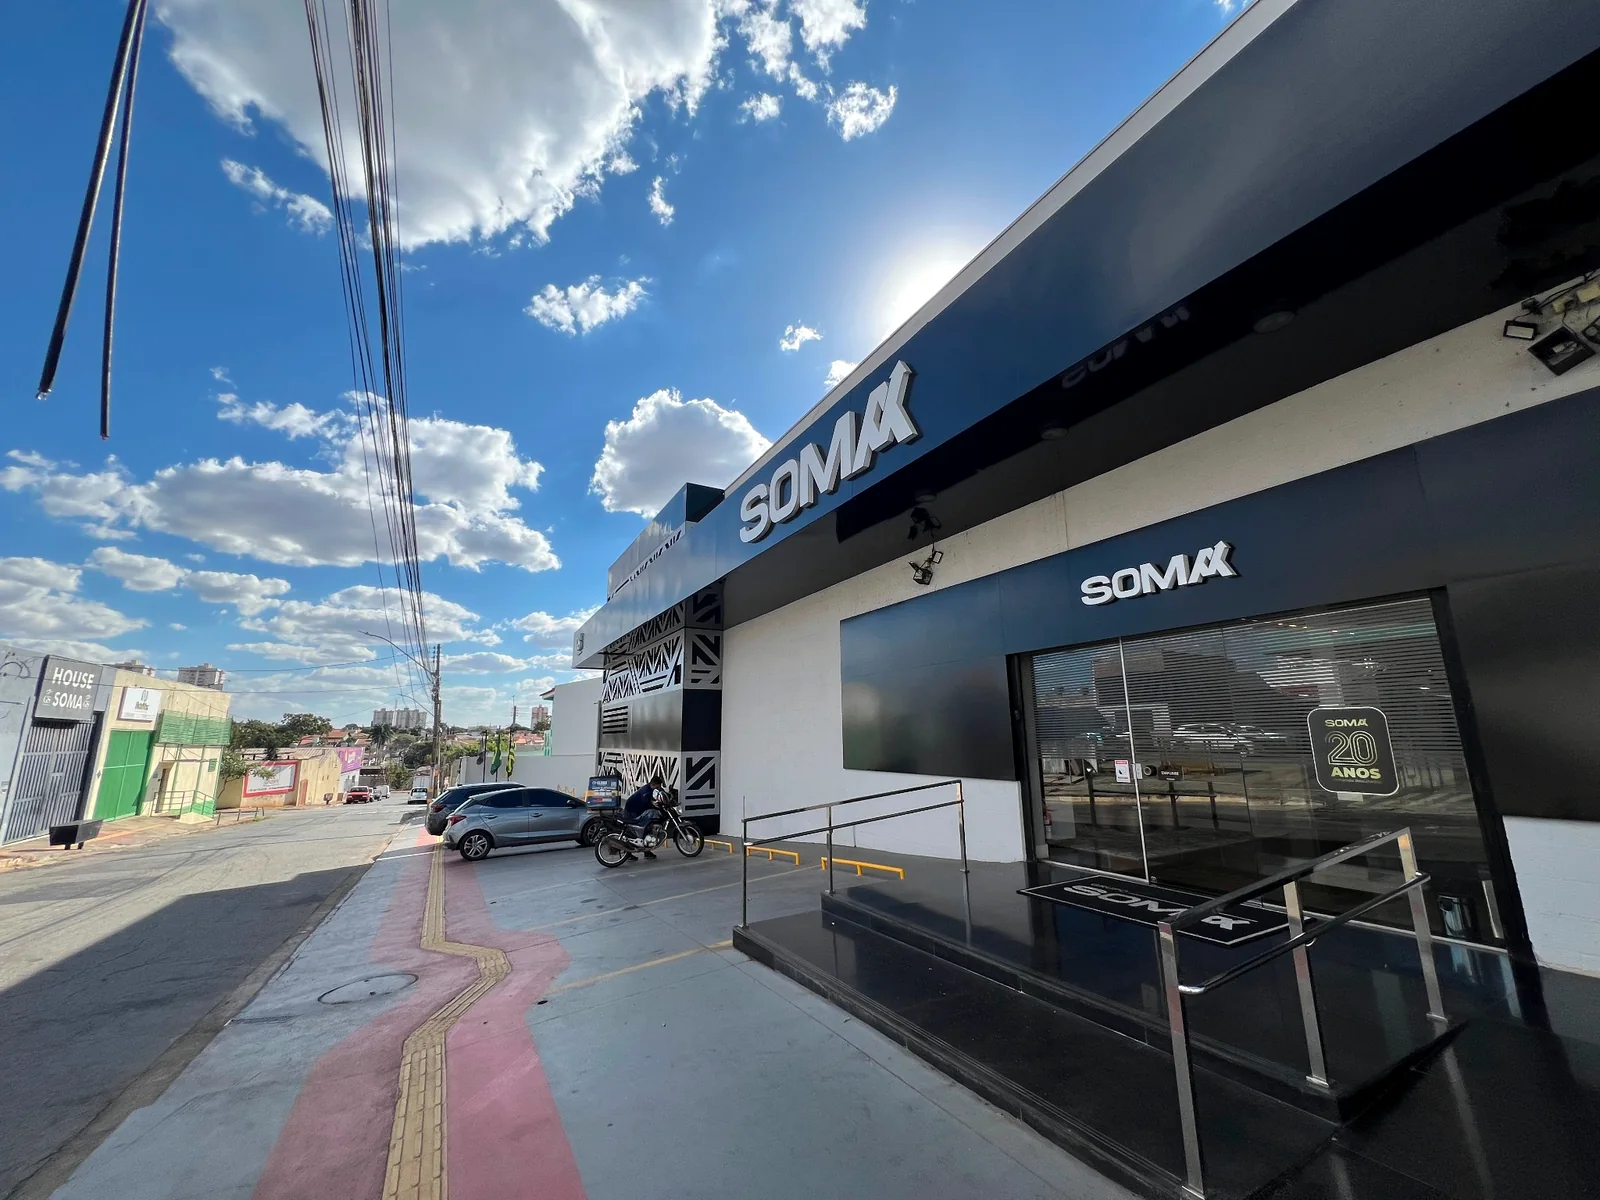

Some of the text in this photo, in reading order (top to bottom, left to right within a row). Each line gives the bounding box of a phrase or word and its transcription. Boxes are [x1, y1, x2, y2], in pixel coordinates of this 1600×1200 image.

[739, 360, 920, 544] SOMA
[1080, 540, 1237, 606] SOMA
[52, 667, 95, 689] HOUSE
[52, 691, 83, 709] SOMA
[1325, 718, 1368, 727] SOMA
[1325, 730, 1378, 766] 20
[1331, 767, 1381, 779] ANOS
